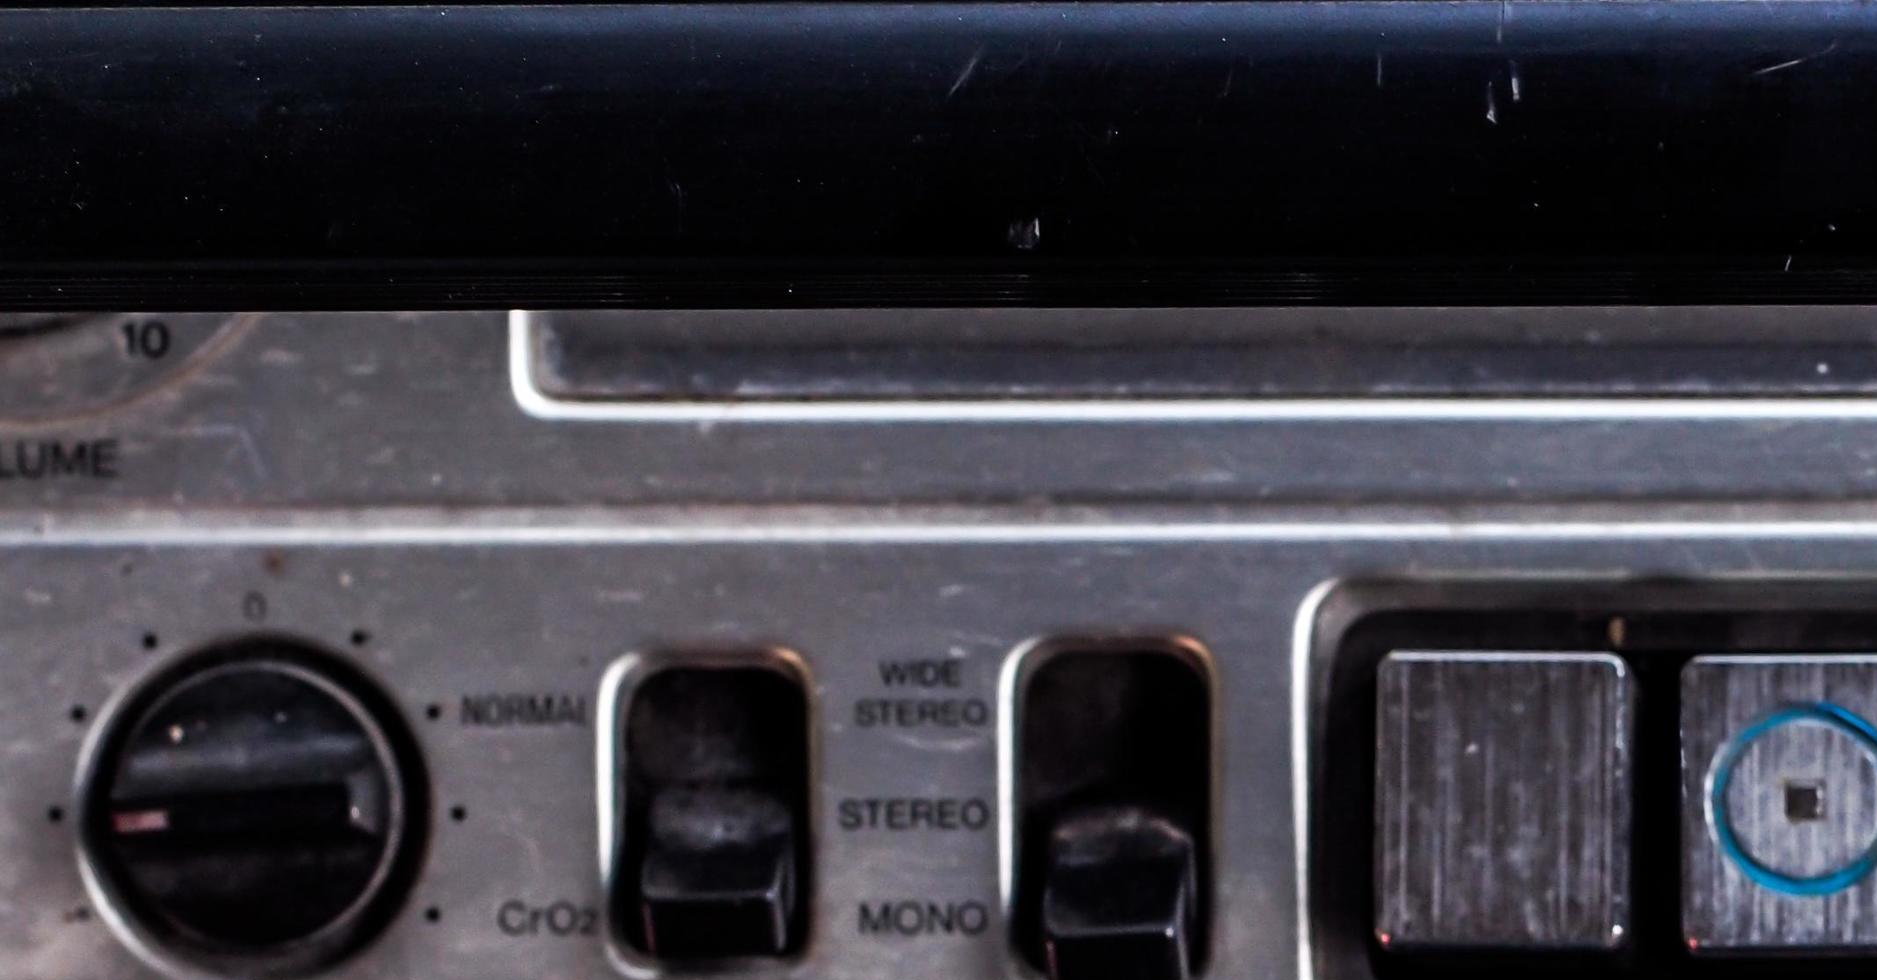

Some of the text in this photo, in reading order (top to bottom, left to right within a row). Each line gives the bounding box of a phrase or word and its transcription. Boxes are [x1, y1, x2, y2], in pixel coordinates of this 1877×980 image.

[122, 320, 169, 358] 10
[242, 590, 267, 621] 0
[879, 660, 963, 687] WIDE
[854, 699, 988, 727] STEREO
[838, 799, 989, 831] STEREO
[857, 902, 989, 935] MONO
